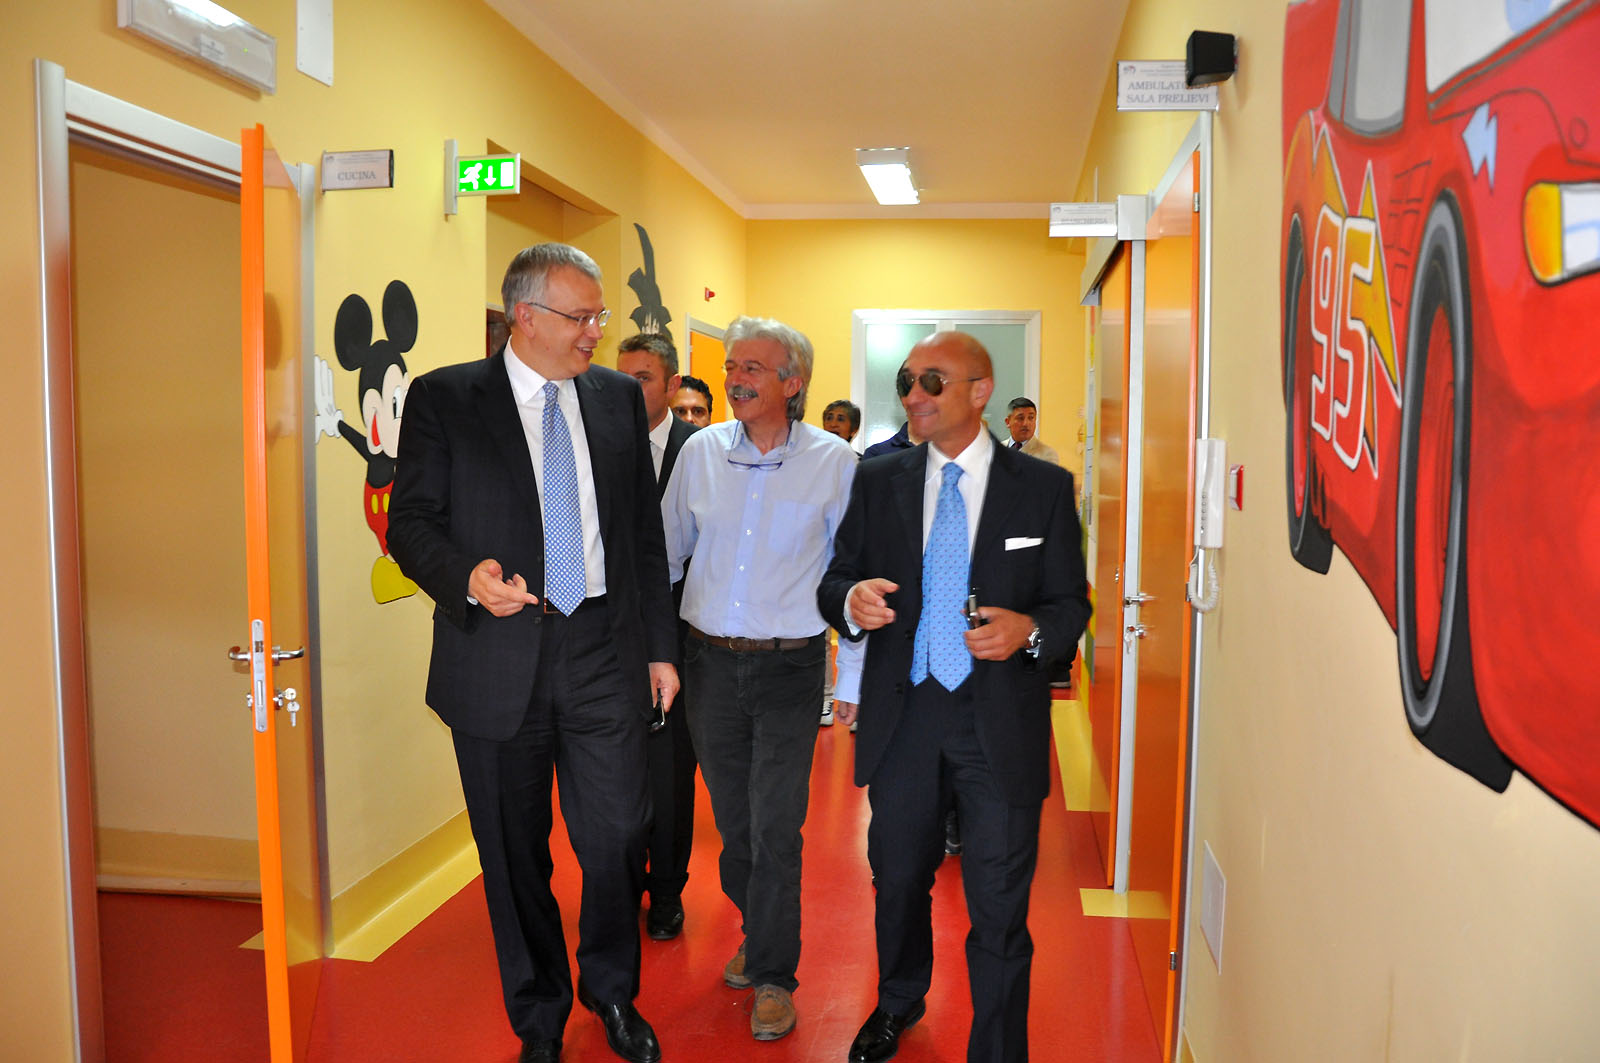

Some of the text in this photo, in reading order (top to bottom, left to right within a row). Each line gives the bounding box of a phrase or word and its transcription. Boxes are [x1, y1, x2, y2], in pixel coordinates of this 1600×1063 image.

[1127, 80, 1209, 90] AMBULAT
[1127, 93, 1209, 103] SALA PRELIEVI
[337, 171, 377, 181] CUCINA
[1311, 203, 1377, 471] 95
